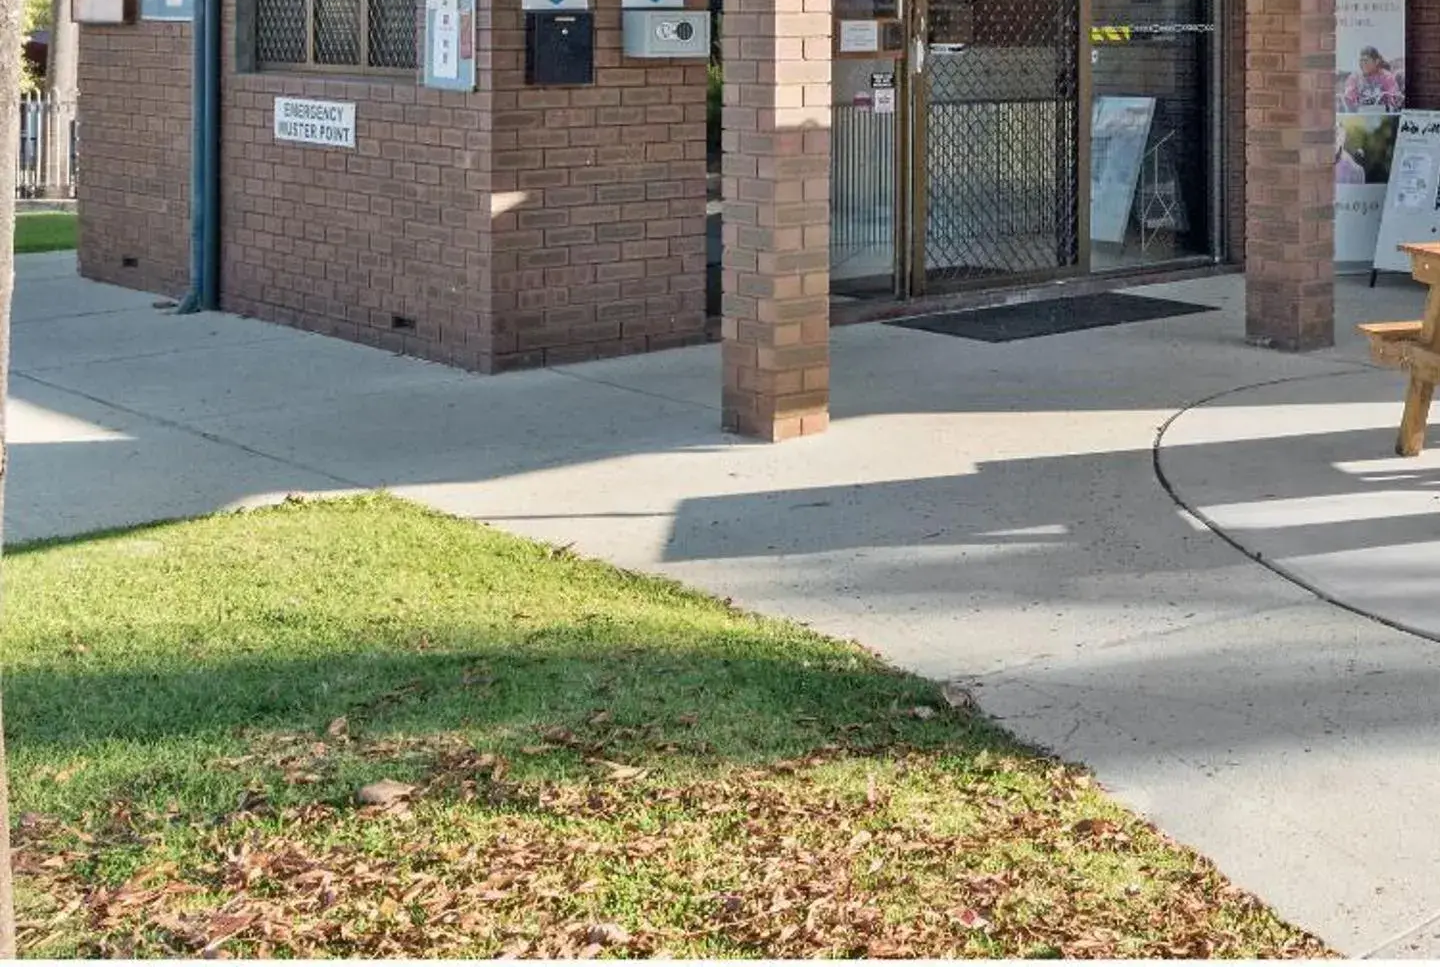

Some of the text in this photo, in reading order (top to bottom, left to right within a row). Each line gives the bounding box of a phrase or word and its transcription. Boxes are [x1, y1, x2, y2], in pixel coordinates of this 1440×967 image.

[283, 101, 345, 122] EMERGENCY
[278, 121, 351, 143] USTER POINT
